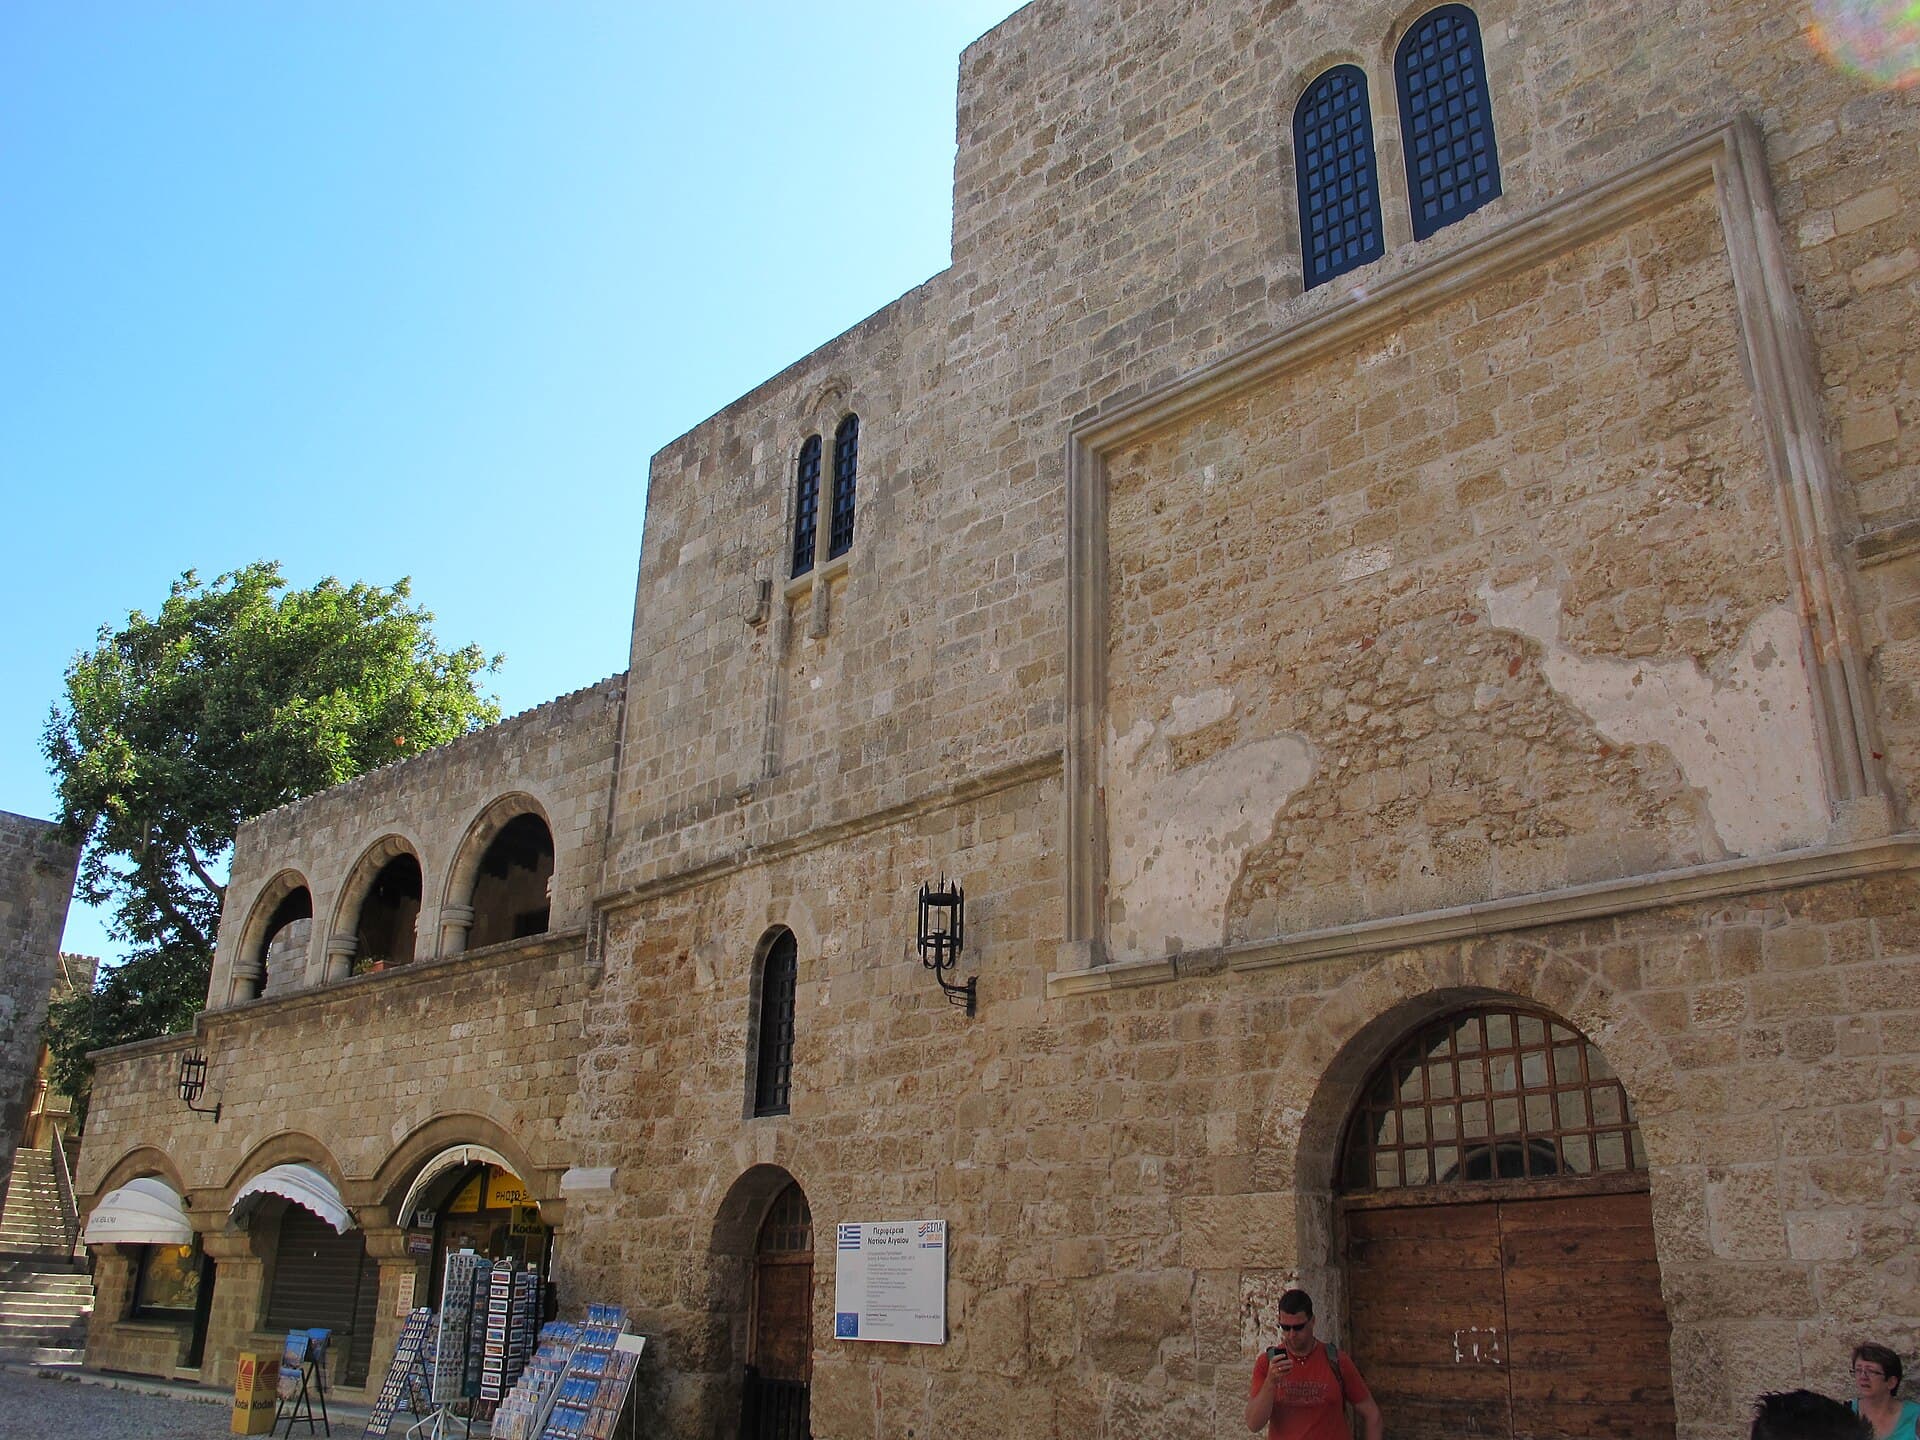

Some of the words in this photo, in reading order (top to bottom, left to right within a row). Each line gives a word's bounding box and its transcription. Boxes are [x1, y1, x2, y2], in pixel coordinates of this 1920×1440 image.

[513, 1223, 543, 1235] Kodak
[235, 1398, 249, 1410] Kodak
[253, 1398, 275, 1411] Kodak
